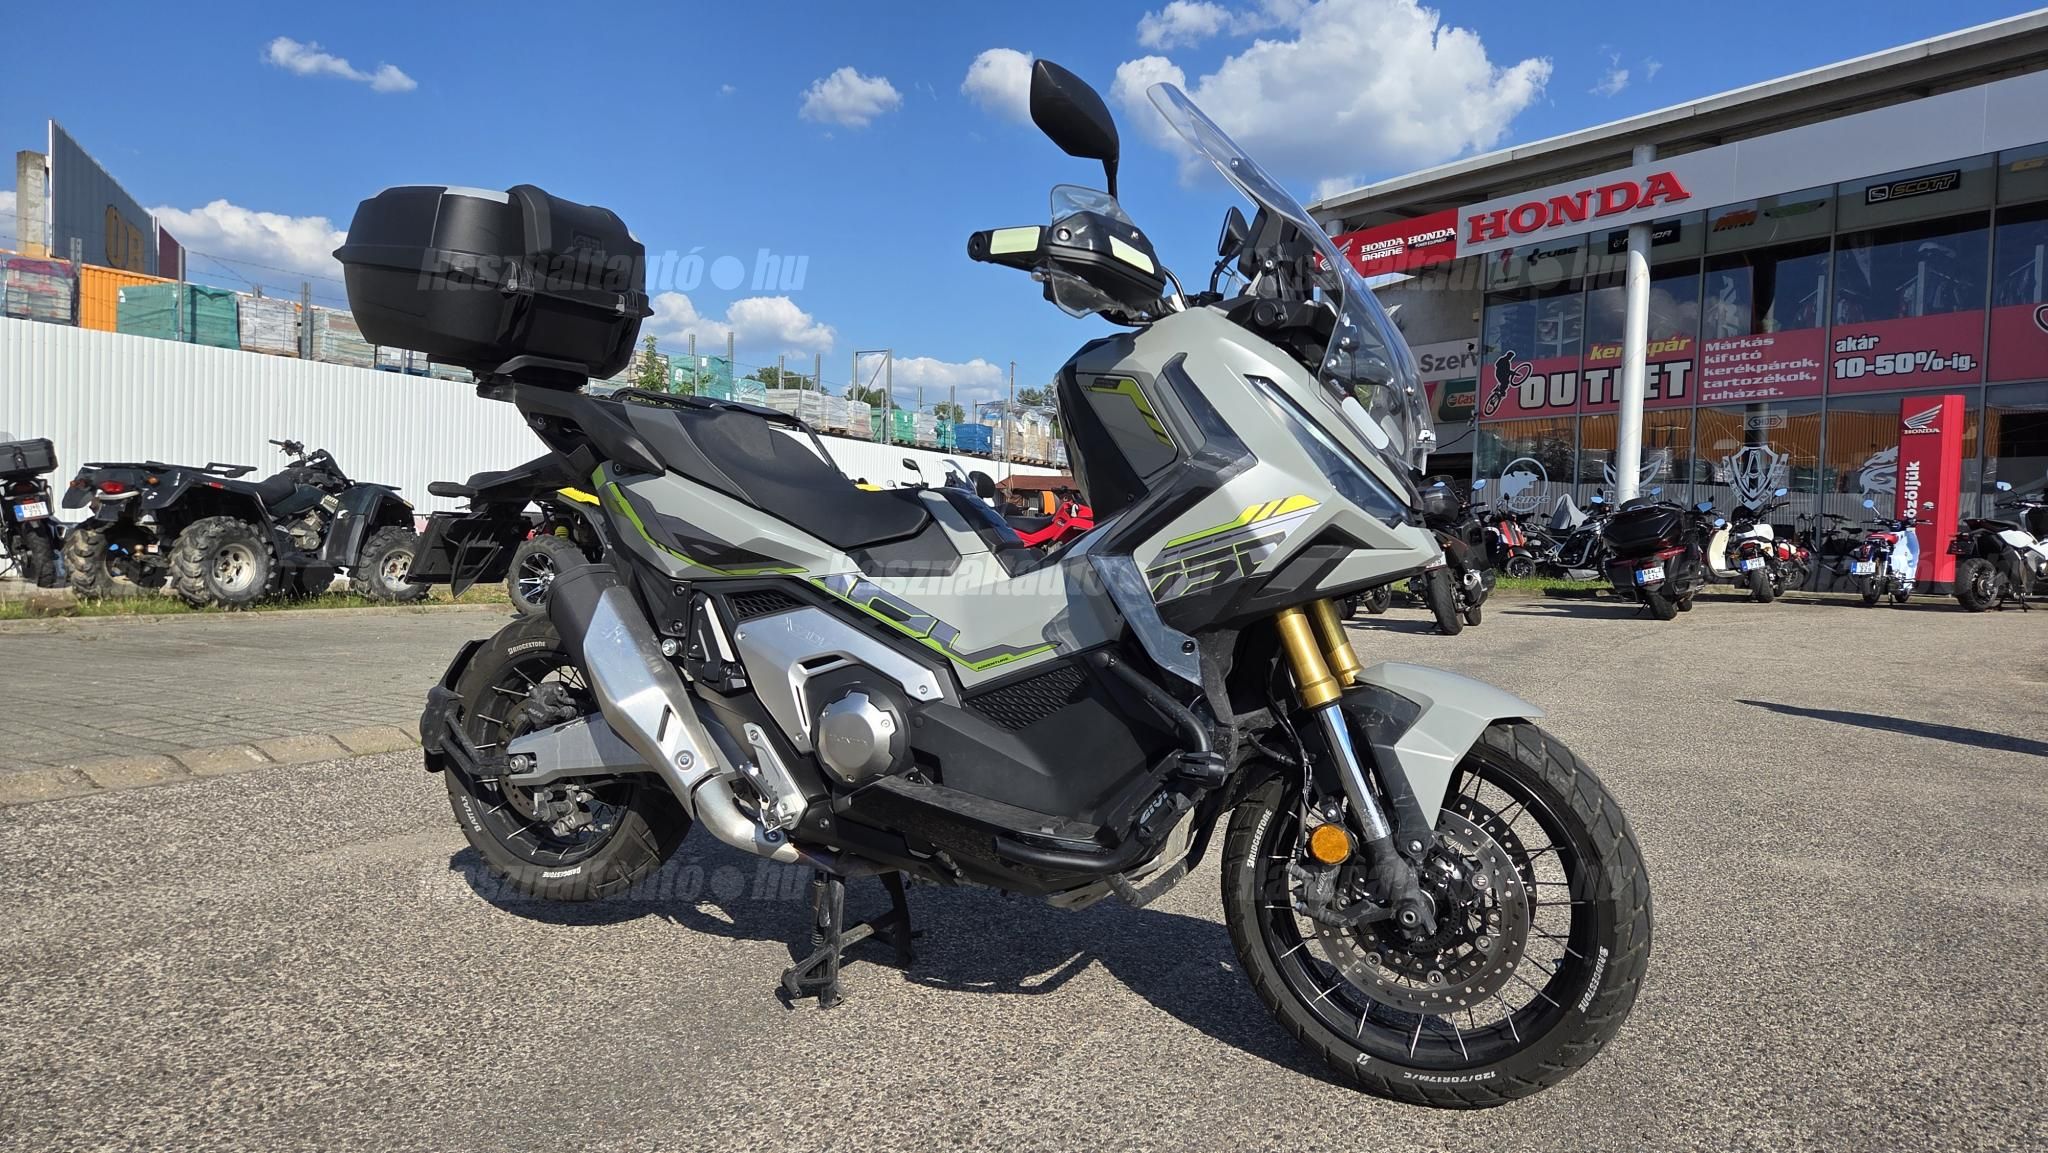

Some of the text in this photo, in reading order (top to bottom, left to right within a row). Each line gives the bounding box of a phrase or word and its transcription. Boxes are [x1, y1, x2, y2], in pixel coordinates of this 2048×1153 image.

[1892, 173, 1957, 198] SCOTT
[1467, 171, 1691, 245] HONDA
[1361, 237, 1405, 253] HONDA
[1407, 227, 1457, 245] HONDA
[1361, 247, 1404, 262] MARINE
[1537, 245, 1580, 259] CUBE
[1705, 337, 1775, 352] Márkás
[1835, 334, 1880, 353] akár
[1704, 350, 1762, 364] kifutó
[1833, 350, 1977, 379] 10-50%-ig.
[1704, 358, 1820, 377] kerékpárok,
[1703, 371, 1817, 389] tartozékok,
[1702, 387, 1785, 401] ruházat.
[1904, 427, 1940, 435] HONDA
[1246, 807, 1273, 869] BRIDGESTONE
[1577, 945, 1609, 1014] BRIDGESTONE
[1403, 1070, 1497, 1084] 120/70R17M/C
